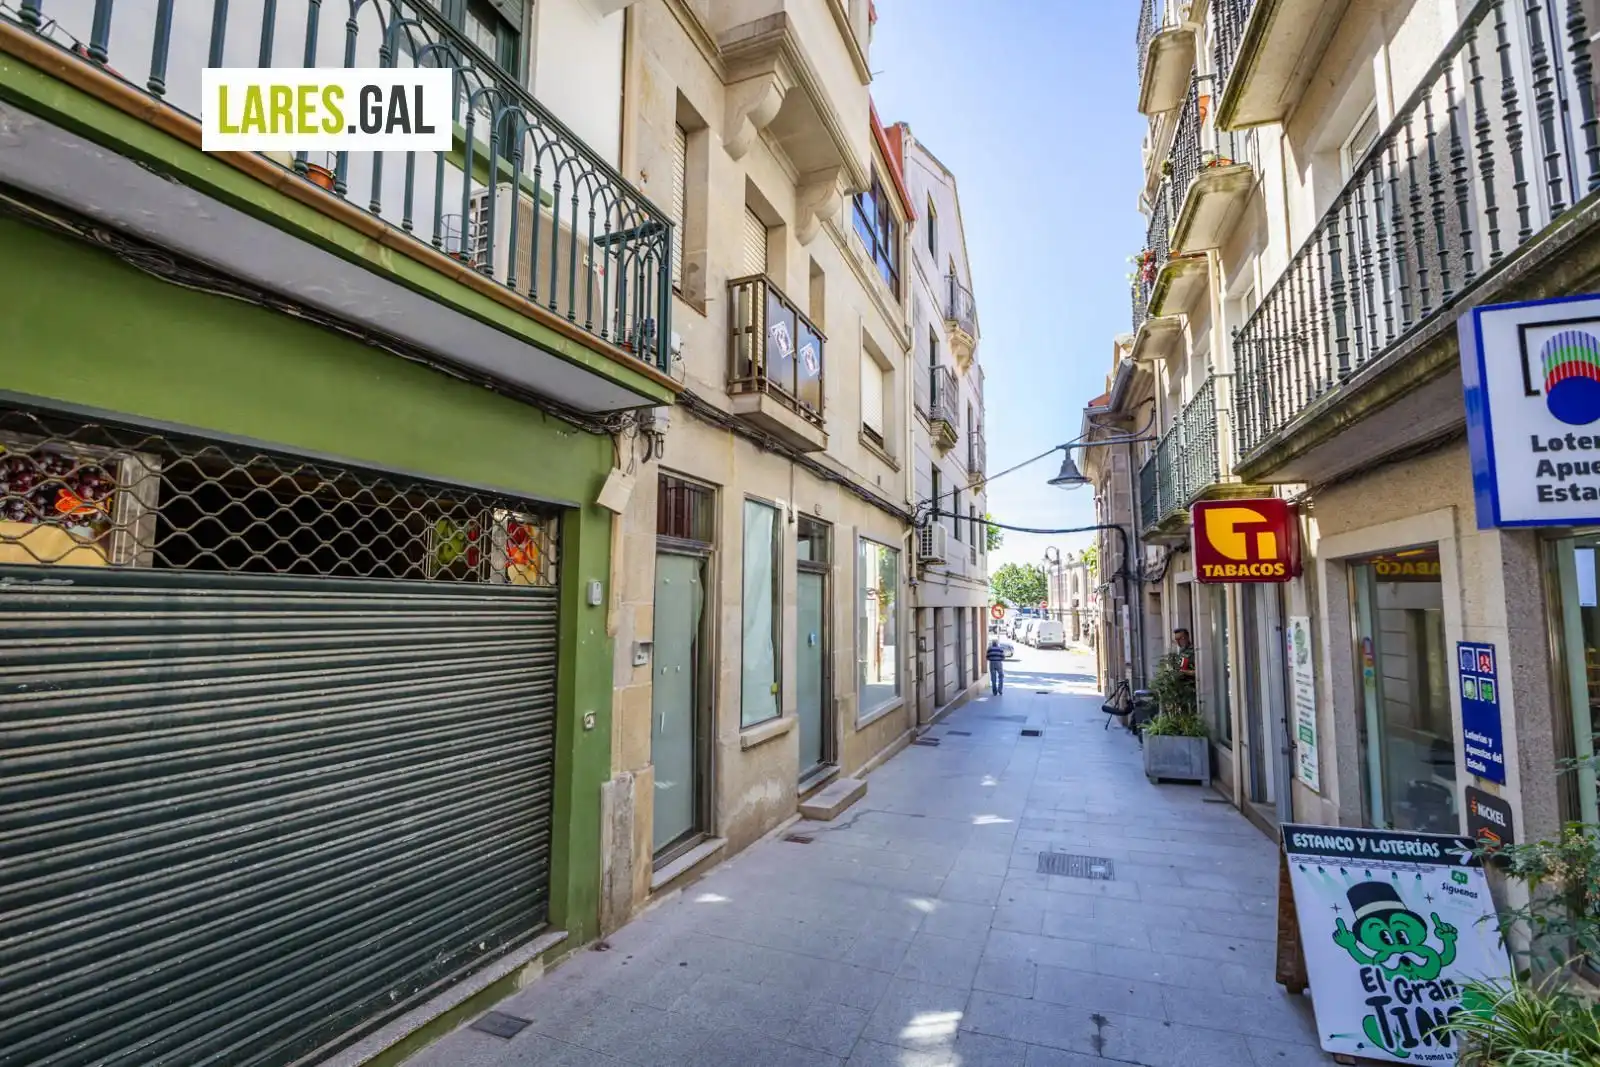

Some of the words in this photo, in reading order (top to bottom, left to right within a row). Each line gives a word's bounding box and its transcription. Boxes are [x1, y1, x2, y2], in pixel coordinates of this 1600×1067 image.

[1536, 483, 1600, 502] Esta
[1202, 563, 1285, 577] TABACOS
[1492, 751, 1503, 764] del
[1292, 833, 1354, 852] ESTANCO
[1356, 837, 1367, 852] Y
[1370, 838, 1441, 858] LOTERÍAS
[1360, 966, 1387, 994] El
[1394, 977, 1459, 1005] Gran
